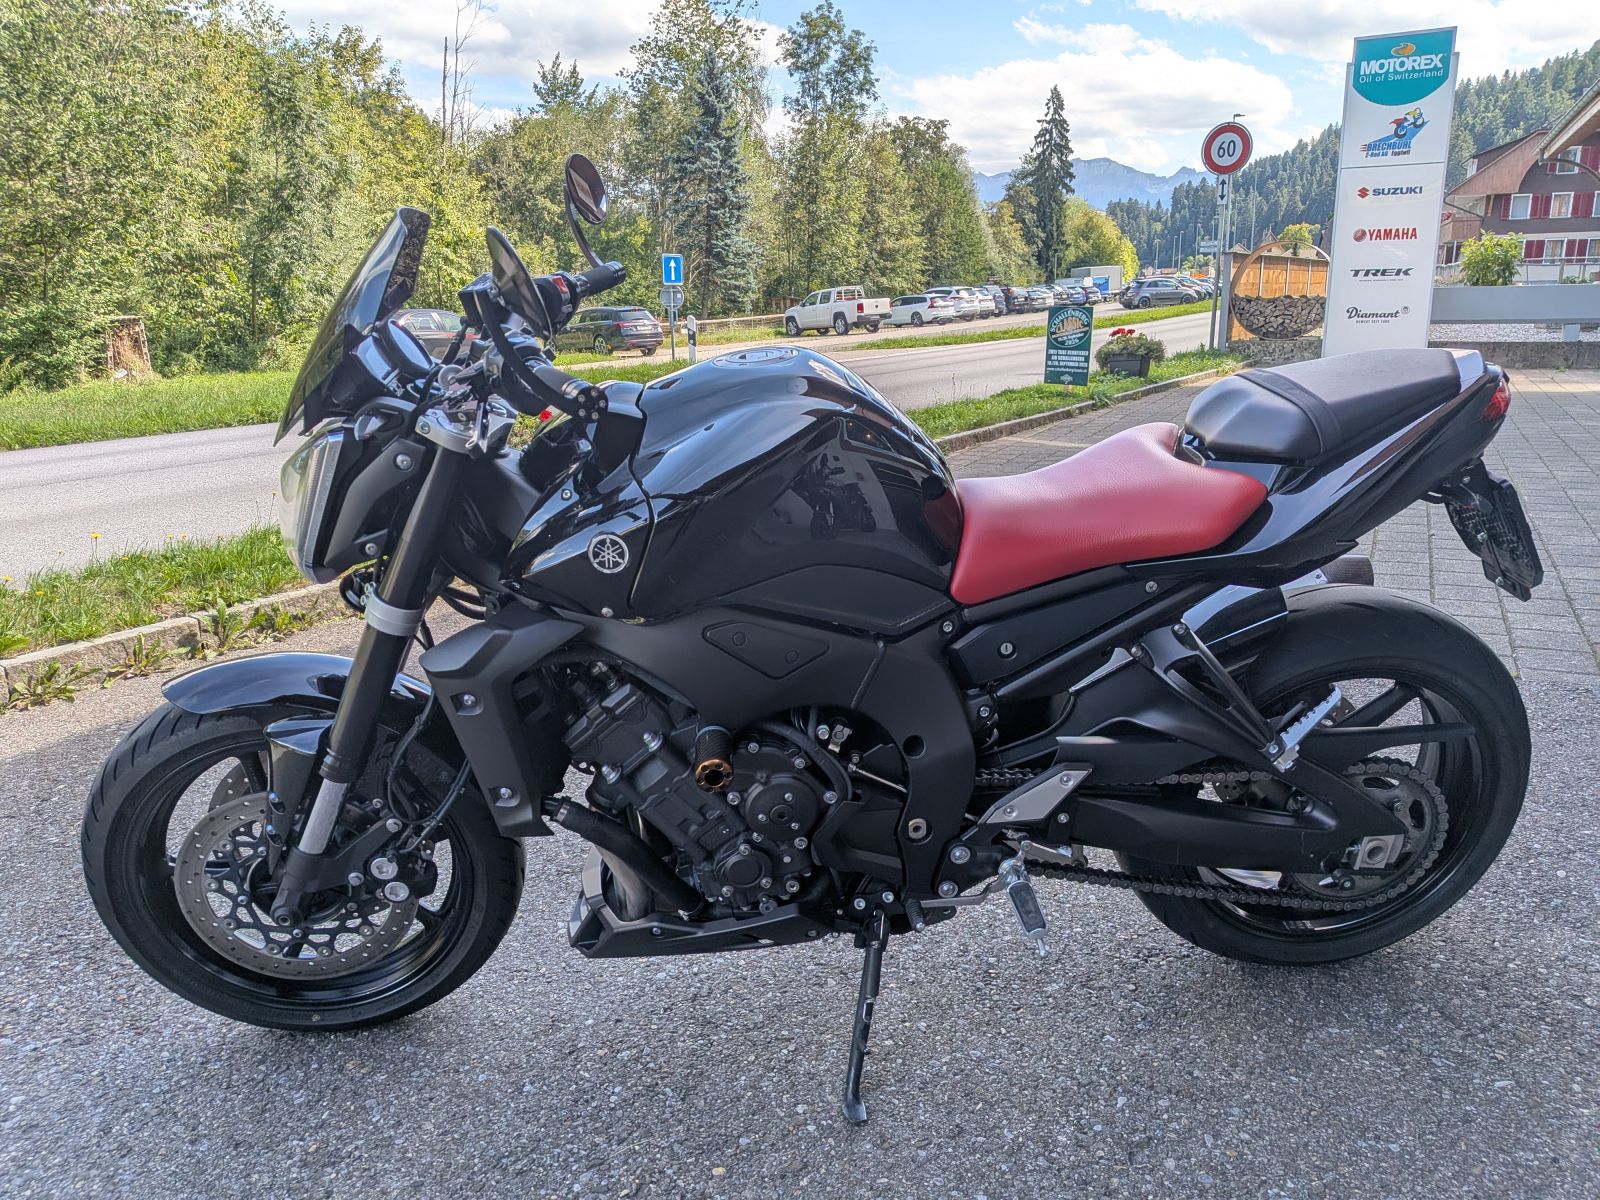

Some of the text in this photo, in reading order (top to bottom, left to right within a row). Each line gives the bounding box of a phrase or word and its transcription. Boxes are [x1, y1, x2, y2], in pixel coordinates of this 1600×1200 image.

[1360, 54, 1444, 75] MOTOREX
[1359, 69, 1443, 83] Oil of Switzerland
[1217, 140, 1236, 158] 60
[1372, 186, 1423, 196] SUZUKI
[1368, 228, 1418, 241] YAMAHA
[1350, 268, 1414, 278] TREK
[1346, 306, 1400, 320] Diamant
[1050, 309, 1089, 333] SCHALLENBERG
